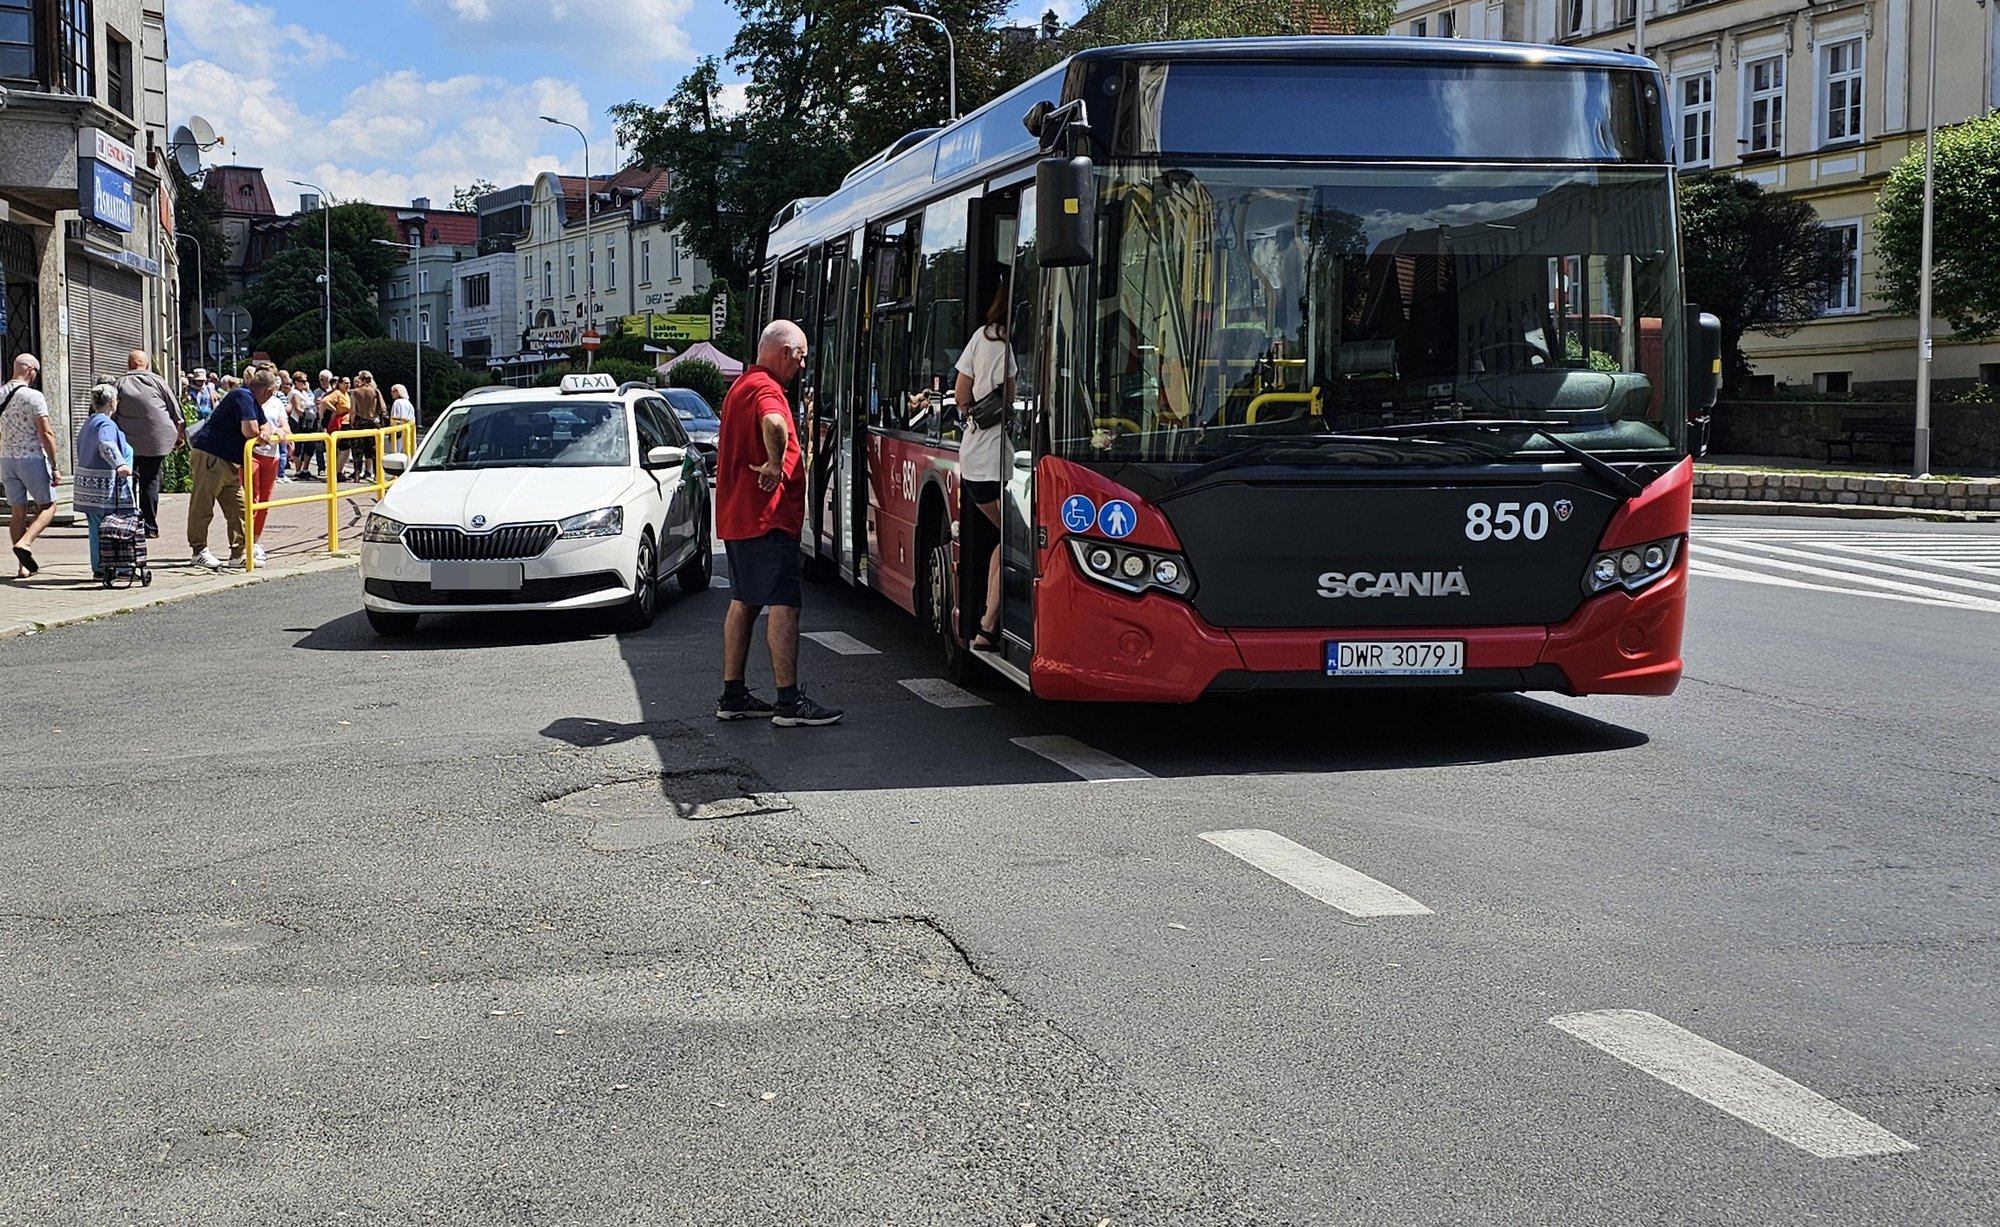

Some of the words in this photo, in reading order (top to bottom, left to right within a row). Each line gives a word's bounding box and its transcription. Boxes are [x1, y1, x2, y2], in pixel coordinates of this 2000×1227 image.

[653, 331, 690, 339] prasowy
[570, 376, 609, 388] TAXI
[902, 460, 917, 502] 850
[1465, 502, 1549, 541] 850
[1316, 571, 1471, 598] SCANIA
[1340, 645, 1383, 668] DWR
